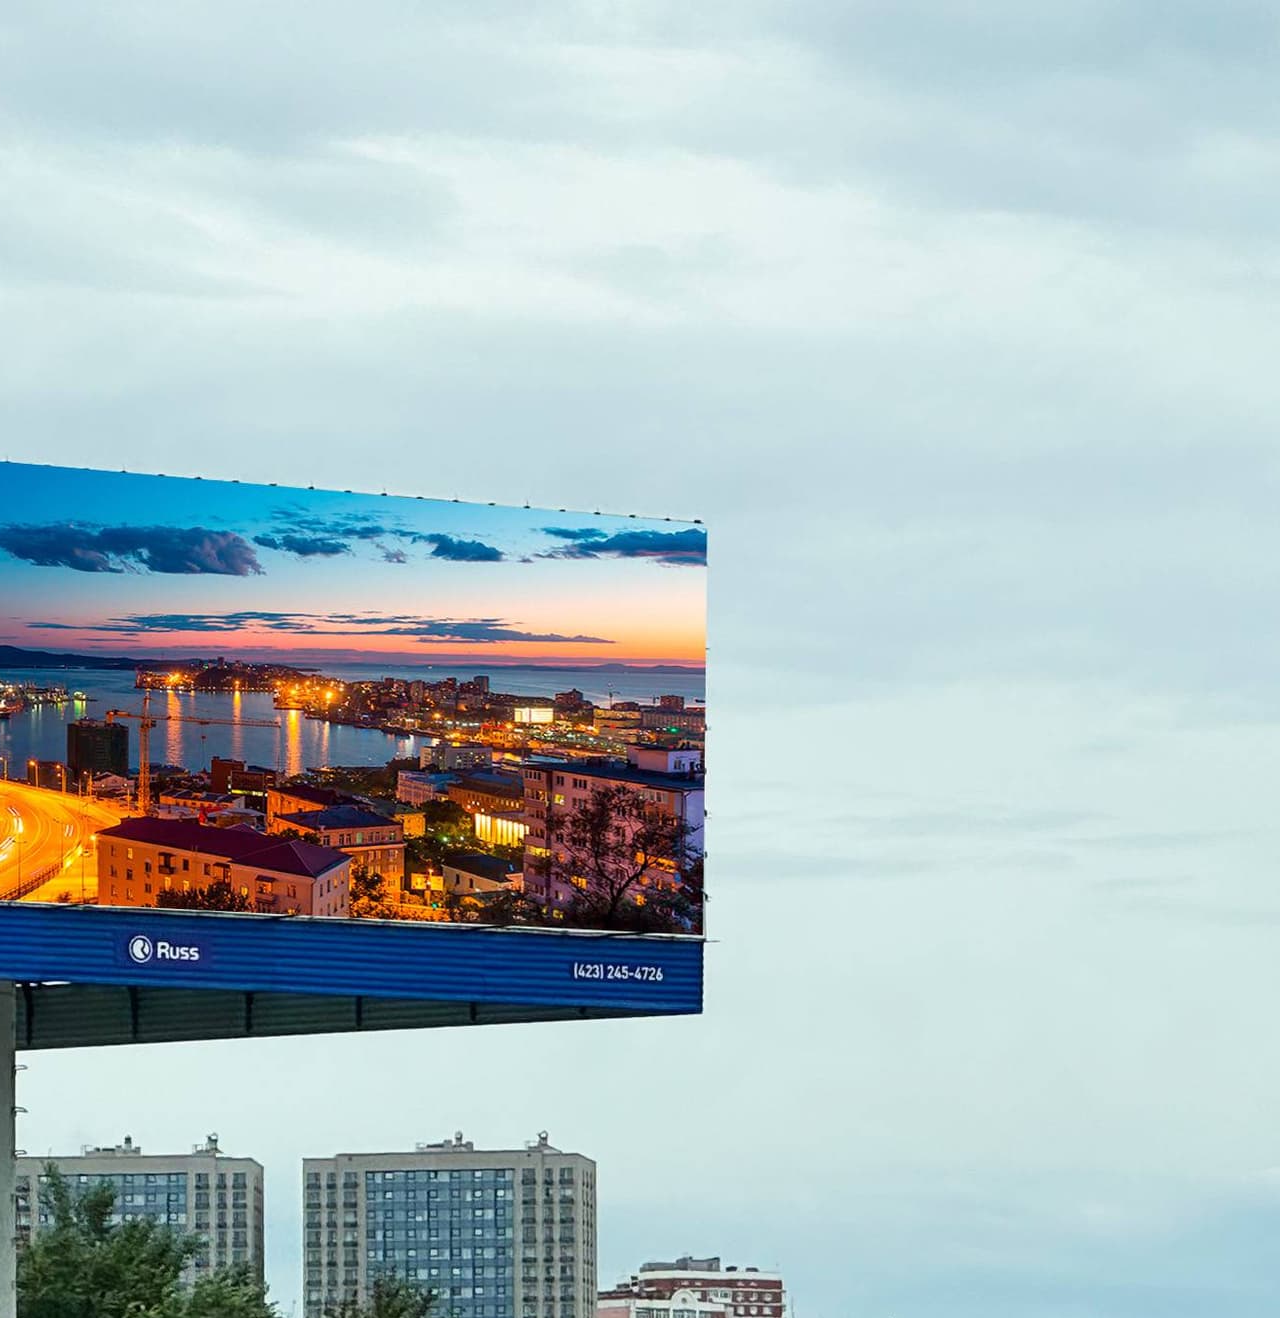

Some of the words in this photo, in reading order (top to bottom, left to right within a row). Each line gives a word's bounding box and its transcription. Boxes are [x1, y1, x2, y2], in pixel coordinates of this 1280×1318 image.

[157, 941, 200, 960] Russ
[573, 961, 605, 979] (423)
[607, 965, 664, 981] 245-4726
